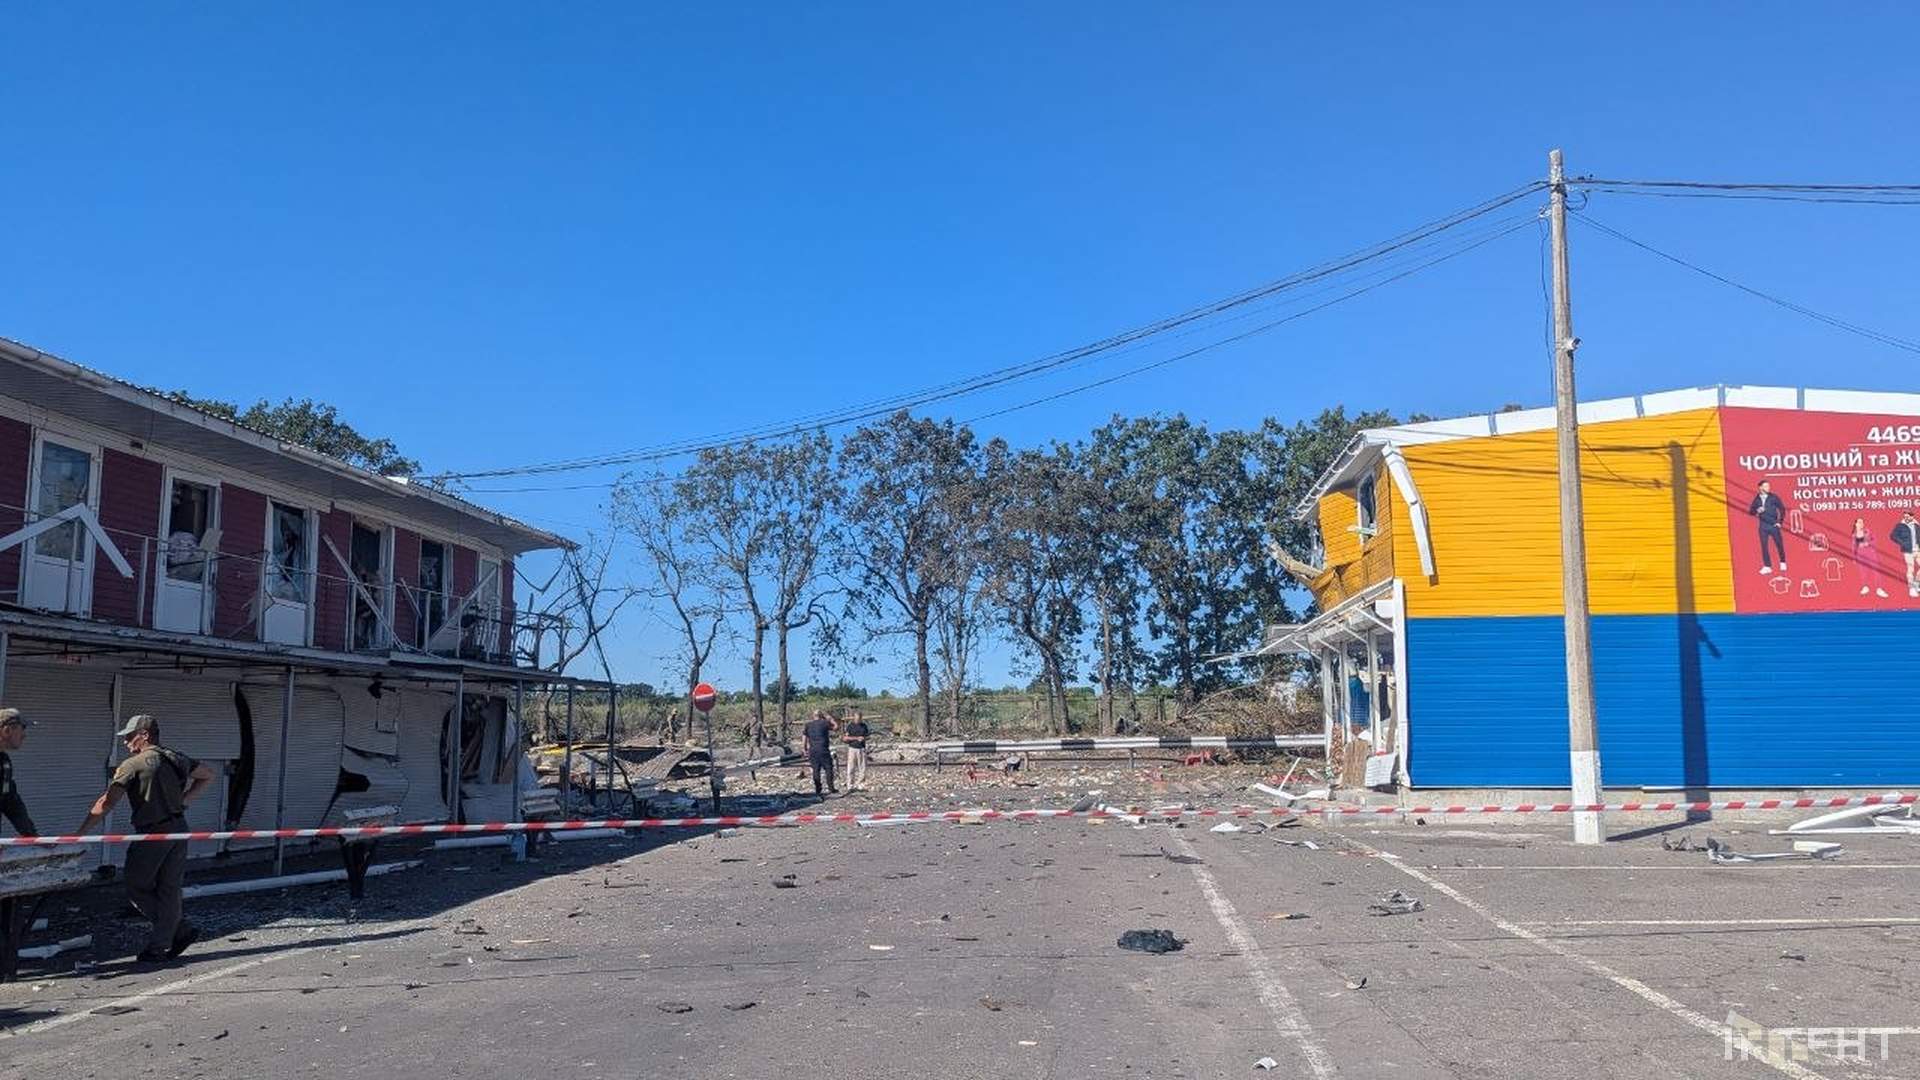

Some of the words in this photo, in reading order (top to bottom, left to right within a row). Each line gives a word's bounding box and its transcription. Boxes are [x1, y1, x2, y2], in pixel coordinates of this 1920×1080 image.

[1866, 426, 1920, 443] 4469
[1739, 448, 1862, 471] ЧОЛОВІЧИЙ
[1867, 454, 1889, 467] та
[1797, 474, 1847, 487] ШТАНИ
[1862, 473, 1913, 484] ШОРТИ
[1793, 487, 1866, 500] КОСТЮМИ
